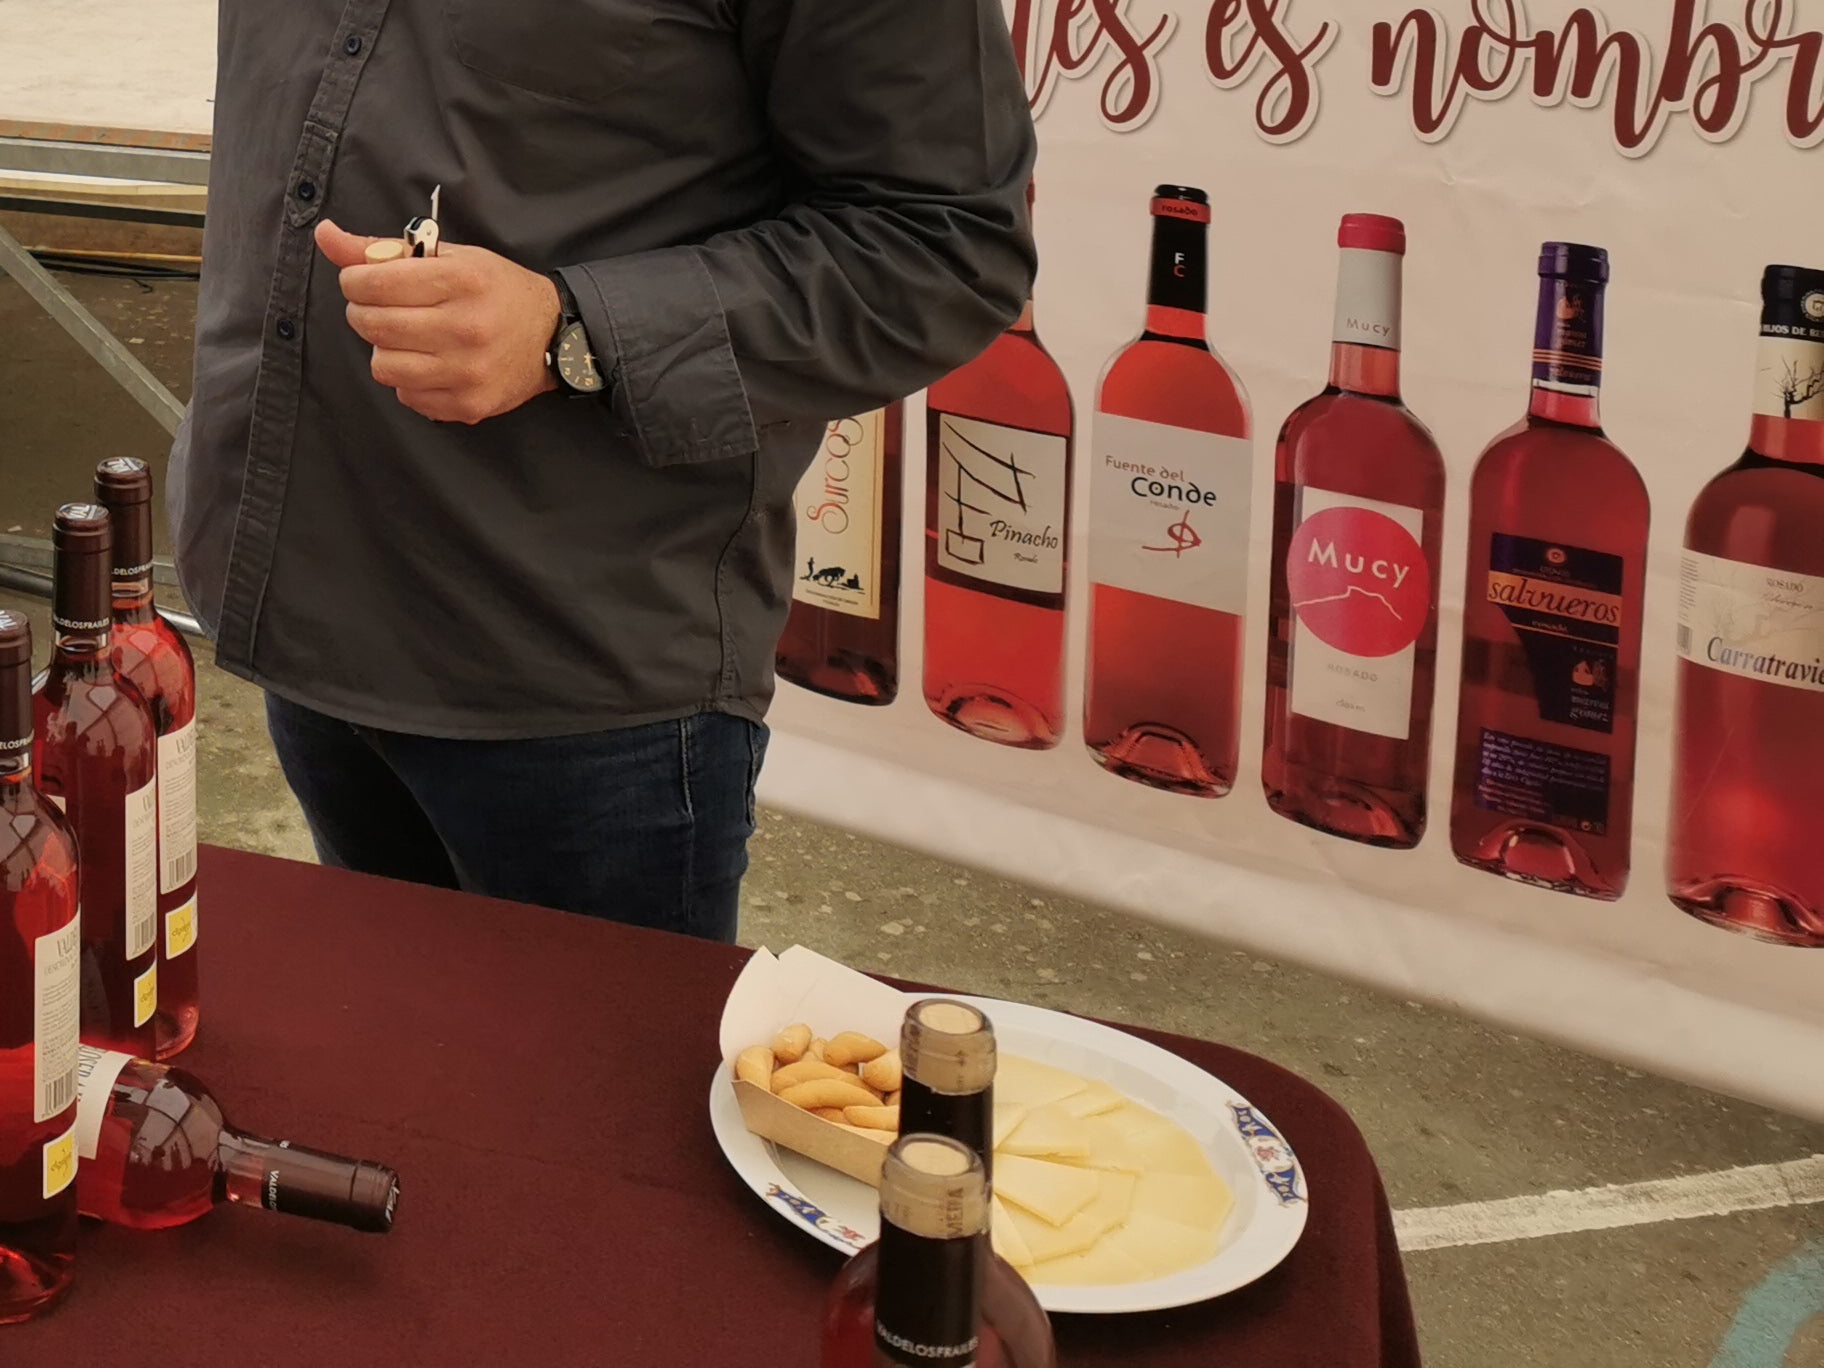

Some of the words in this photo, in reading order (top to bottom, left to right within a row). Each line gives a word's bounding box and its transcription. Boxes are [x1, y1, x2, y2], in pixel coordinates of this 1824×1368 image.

[1162, 205, 1198, 216] rosado
[1174, 265, 1185, 277] C
[1175, 252, 1184, 264] F
[1346, 317, 1391, 338] Mucy
[1106, 455, 1155, 476] Fuente
[1160, 466, 1184, 482] del
[1131, 477, 1216, 507] Conde
[989, 519, 1059, 550] Pinacho
[1308, 537, 1410, 588] Mucy
[1488, 578, 1619, 624] salvueros
